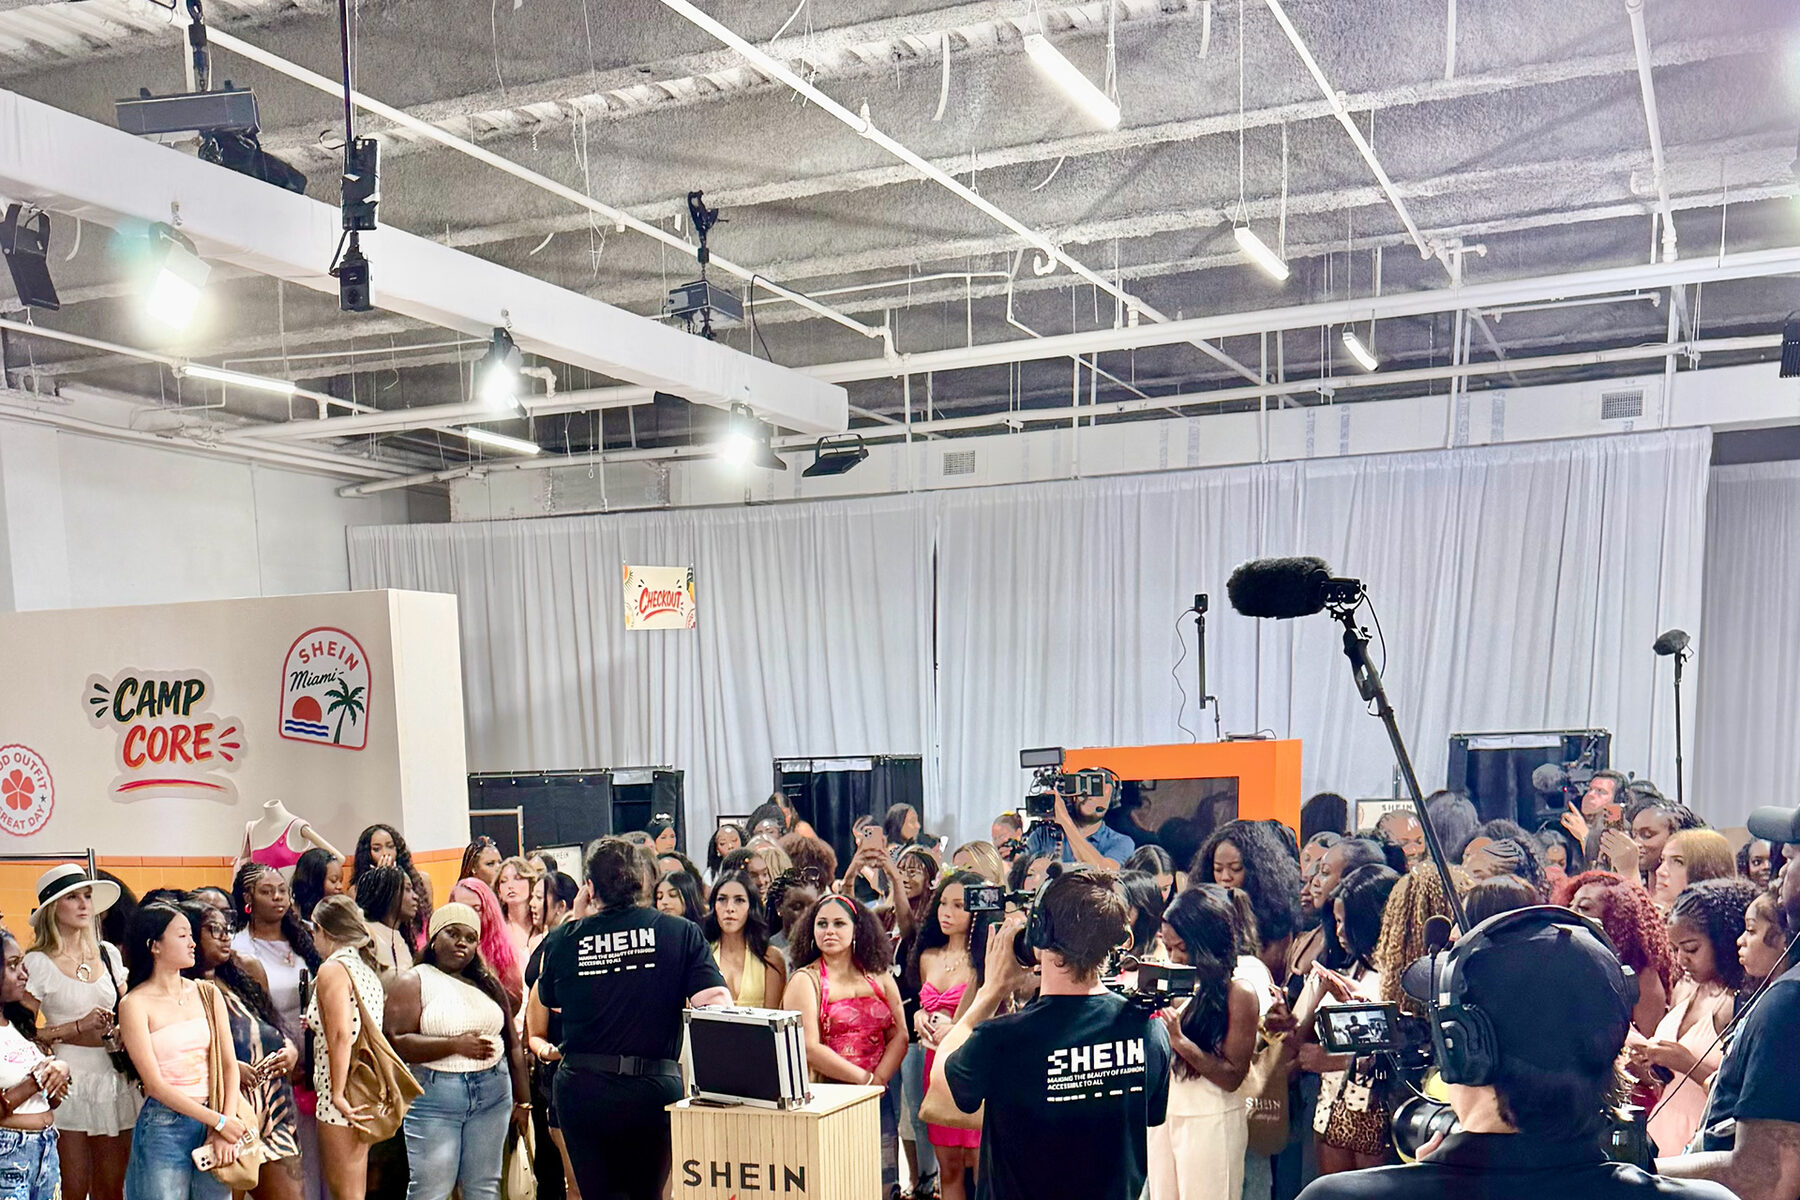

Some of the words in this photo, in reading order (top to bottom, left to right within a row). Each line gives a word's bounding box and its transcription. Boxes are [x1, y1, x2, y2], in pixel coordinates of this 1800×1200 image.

[639, 587, 682, 614] CHECKOUT
[298, 640, 359, 671] SHEIN
[290, 668, 338, 692] Miami
[113, 677, 206, 723] CAMP
[123, 722, 215, 769] CORE
[14, 752, 48, 791] OUTFIT
[0, 806, 26, 830] REAT
[28, 804, 45, 828] DAY
[578, 927, 656, 956] SHEIN
[1047, 1037, 1145, 1076] SHEIN
[1047, 1074, 1073, 1083] MAKING
[1074, 1073, 1086, 1081] THE
[1086, 1070, 1110, 1079] BEAUTY
[1110, 1068, 1119, 1076] OF
[1119, 1066, 1145, 1075] FASHION
[1093, 1078, 1104, 1086] ALL
[682, 1159, 806, 1193] SHEIN
